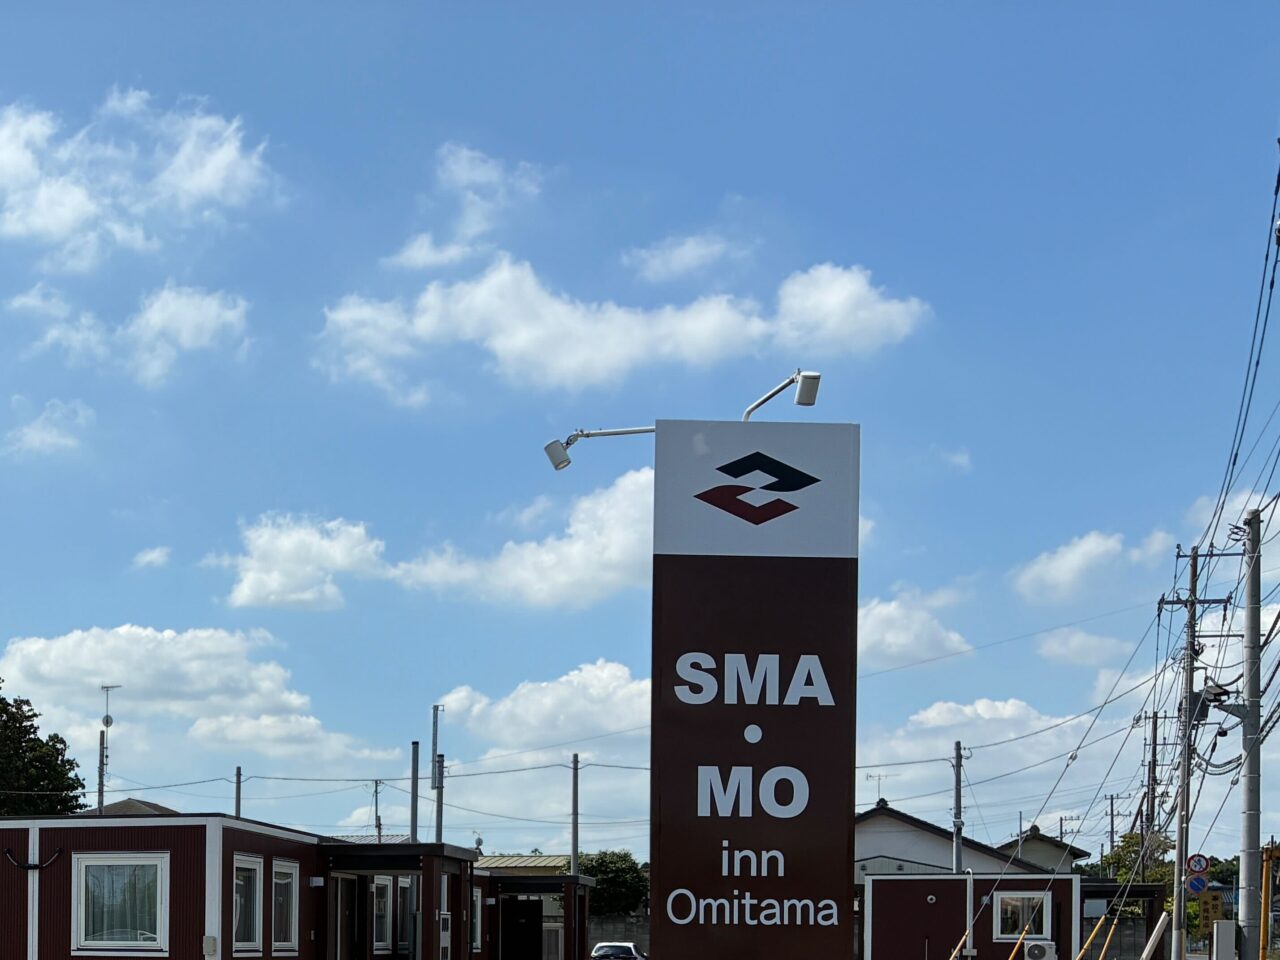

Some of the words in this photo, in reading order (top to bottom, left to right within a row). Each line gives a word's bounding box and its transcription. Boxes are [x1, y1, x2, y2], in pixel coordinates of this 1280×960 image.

[673, 651, 836, 706] SMA
[697, 765, 810, 819] MO
[721, 839, 785, 877] inn
[666, 888, 839, 926] Omitama
